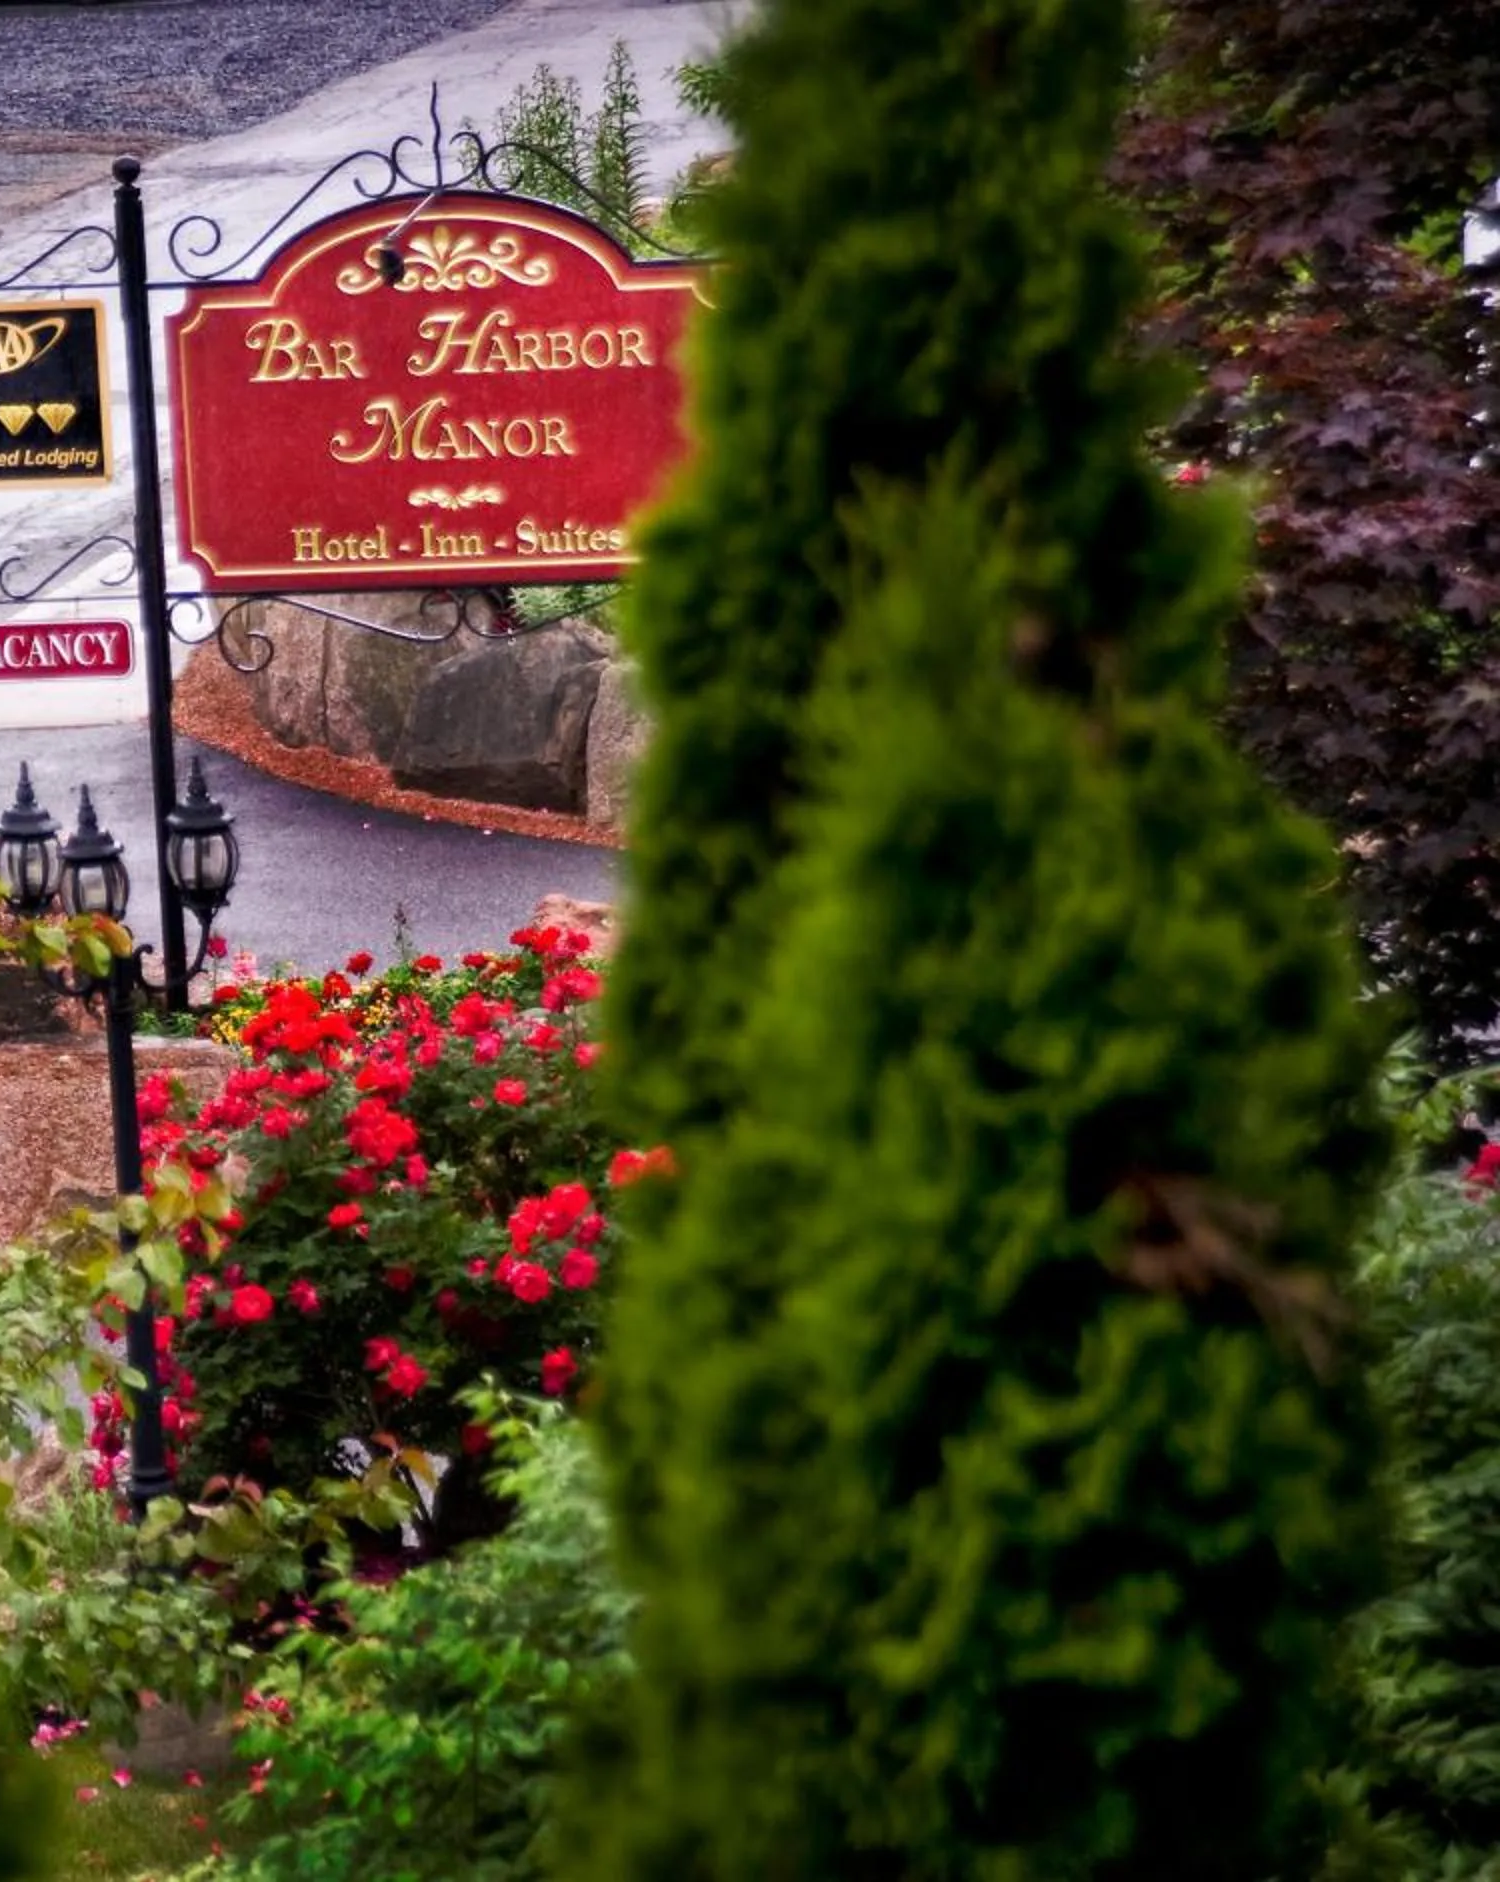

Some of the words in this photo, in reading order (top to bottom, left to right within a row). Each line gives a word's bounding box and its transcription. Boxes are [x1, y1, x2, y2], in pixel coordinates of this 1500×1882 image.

[245, 317, 365, 384] BAR
[407, 309, 654, 377] HARBOR
[24, 447, 99, 469] Lodging
[329, 396, 576, 464] MANOR
[291, 525, 390, 562] Hotel
[419, 523, 485, 558] Inn
[515, 518, 625, 555] Suites
